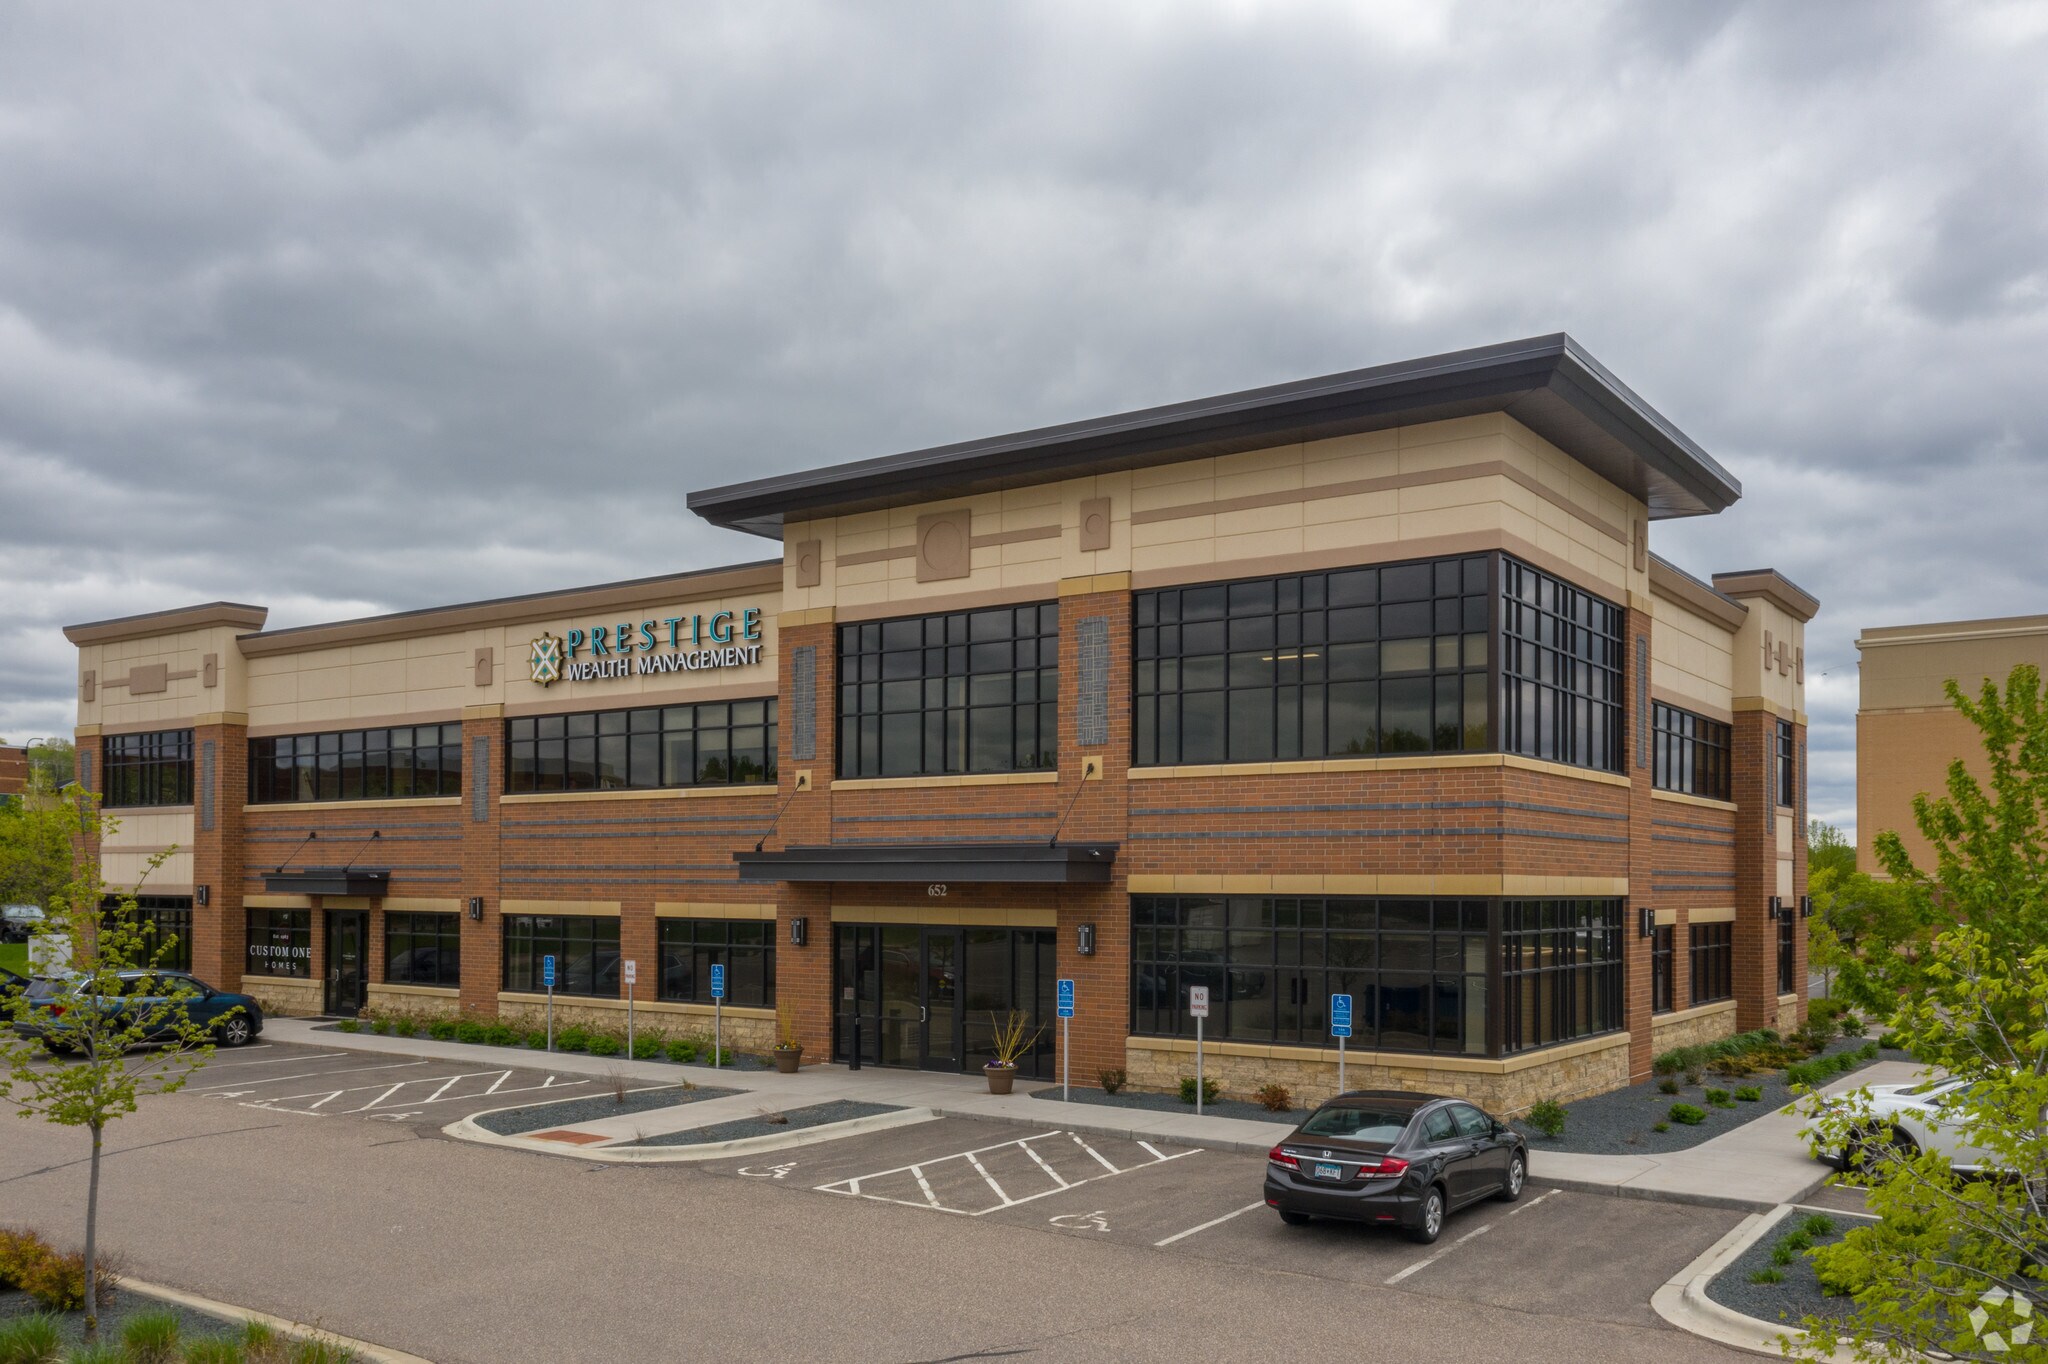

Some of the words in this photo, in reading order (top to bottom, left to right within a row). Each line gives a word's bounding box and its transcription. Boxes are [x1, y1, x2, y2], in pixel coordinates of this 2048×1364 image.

[567, 608, 761, 658] PRESTIGE
[567, 657, 630, 682] WEALTH
[636, 645, 761, 675] MANAGEMENT
[927, 884, 947, 896] 652
[250, 945, 289, 957] CUSTOM
[292, 946, 311, 959] ONE
[264, 960, 297, 970] HOMES
[1194, 992, 1204, 1001] NO
